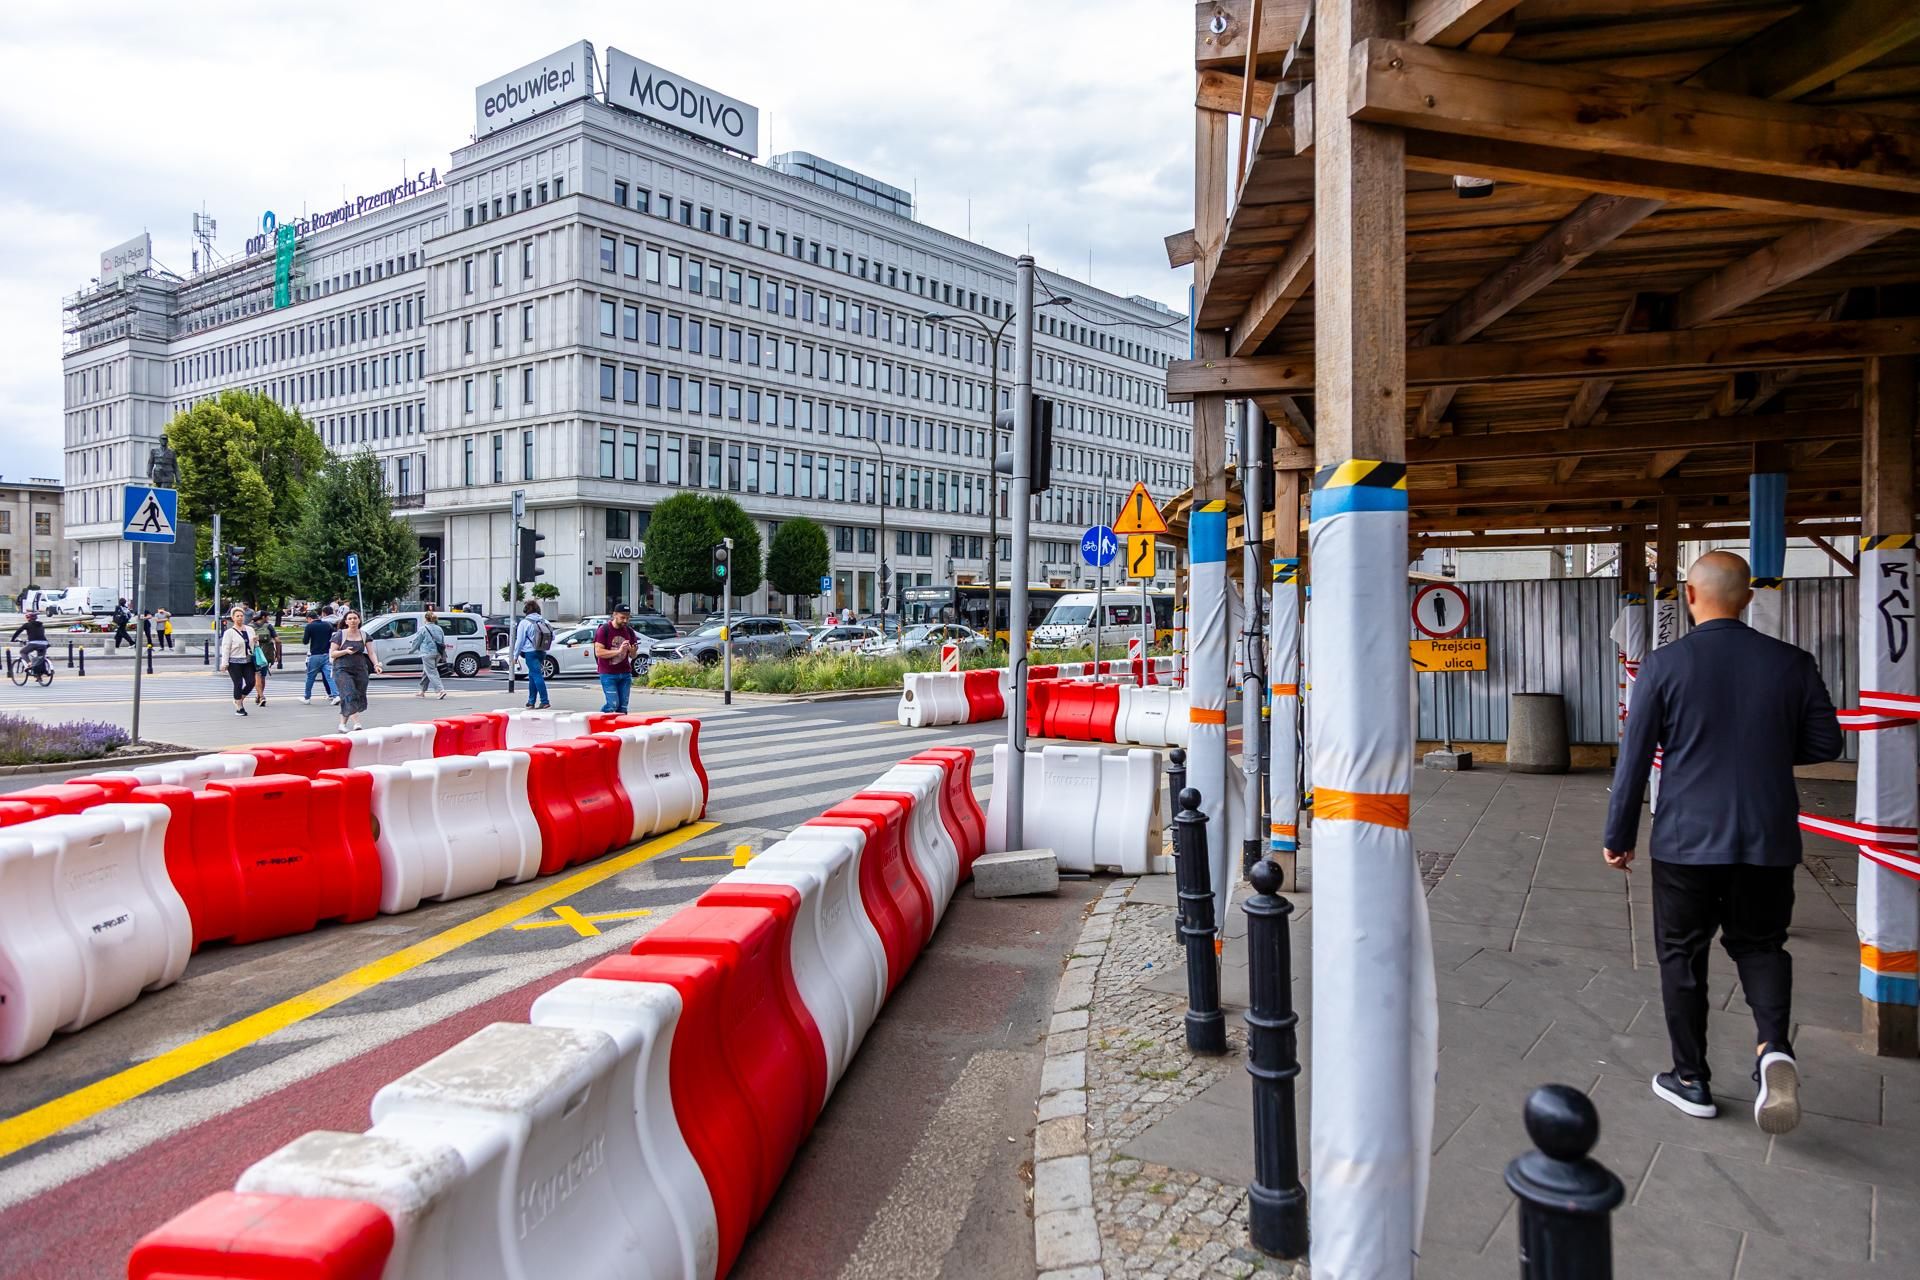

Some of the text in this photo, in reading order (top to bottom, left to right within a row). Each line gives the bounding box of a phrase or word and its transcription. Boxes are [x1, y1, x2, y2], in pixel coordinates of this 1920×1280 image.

[485, 62, 574, 117] eobuwie.pl
[629, 66, 744, 137] MODIVO
[312, 201, 355, 230] Rozwoju
[357, 177, 416, 214] Przemysłu
[418, 168, 442, 192] S.A.
[613, 543, 649, 559] MODI
